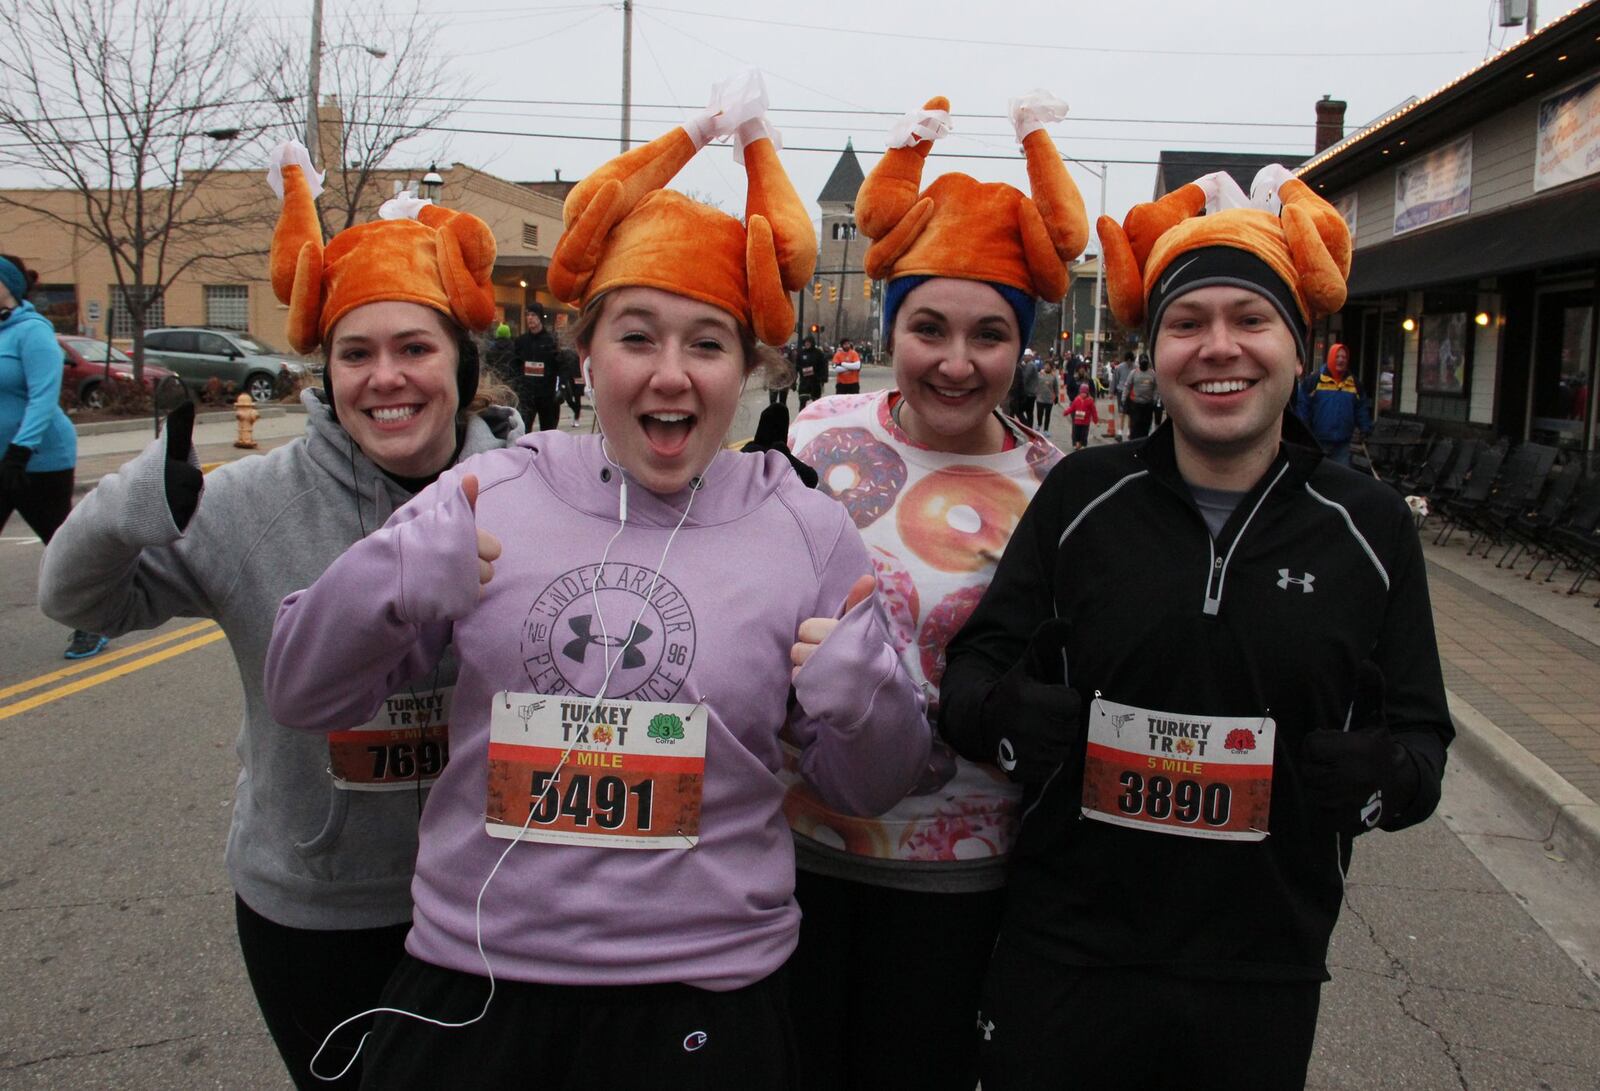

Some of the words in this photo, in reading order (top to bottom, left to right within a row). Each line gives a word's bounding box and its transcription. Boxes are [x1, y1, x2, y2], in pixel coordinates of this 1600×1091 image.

[535, 566, 608, 617] UNDER
[616, 566, 692, 634] ARMOUR
[667, 643, 688, 666] 96
[385, 693, 444, 713] TURKEY
[560, 703, 632, 726] TURKEY
[390, 731, 399, 740] 5
[404, 727, 441, 740] MILE
[662, 726, 670, 737] 3
[1147, 717, 1212, 740] TURKEY
[560, 751, 570, 764] 5
[577, 752, 624, 769] MILE
[1147, 757, 1157, 769] 5
[1162, 759, 1203, 775] MILE
[529, 770, 655, 831] 5491
[1118, 770, 1233, 827] 3890
